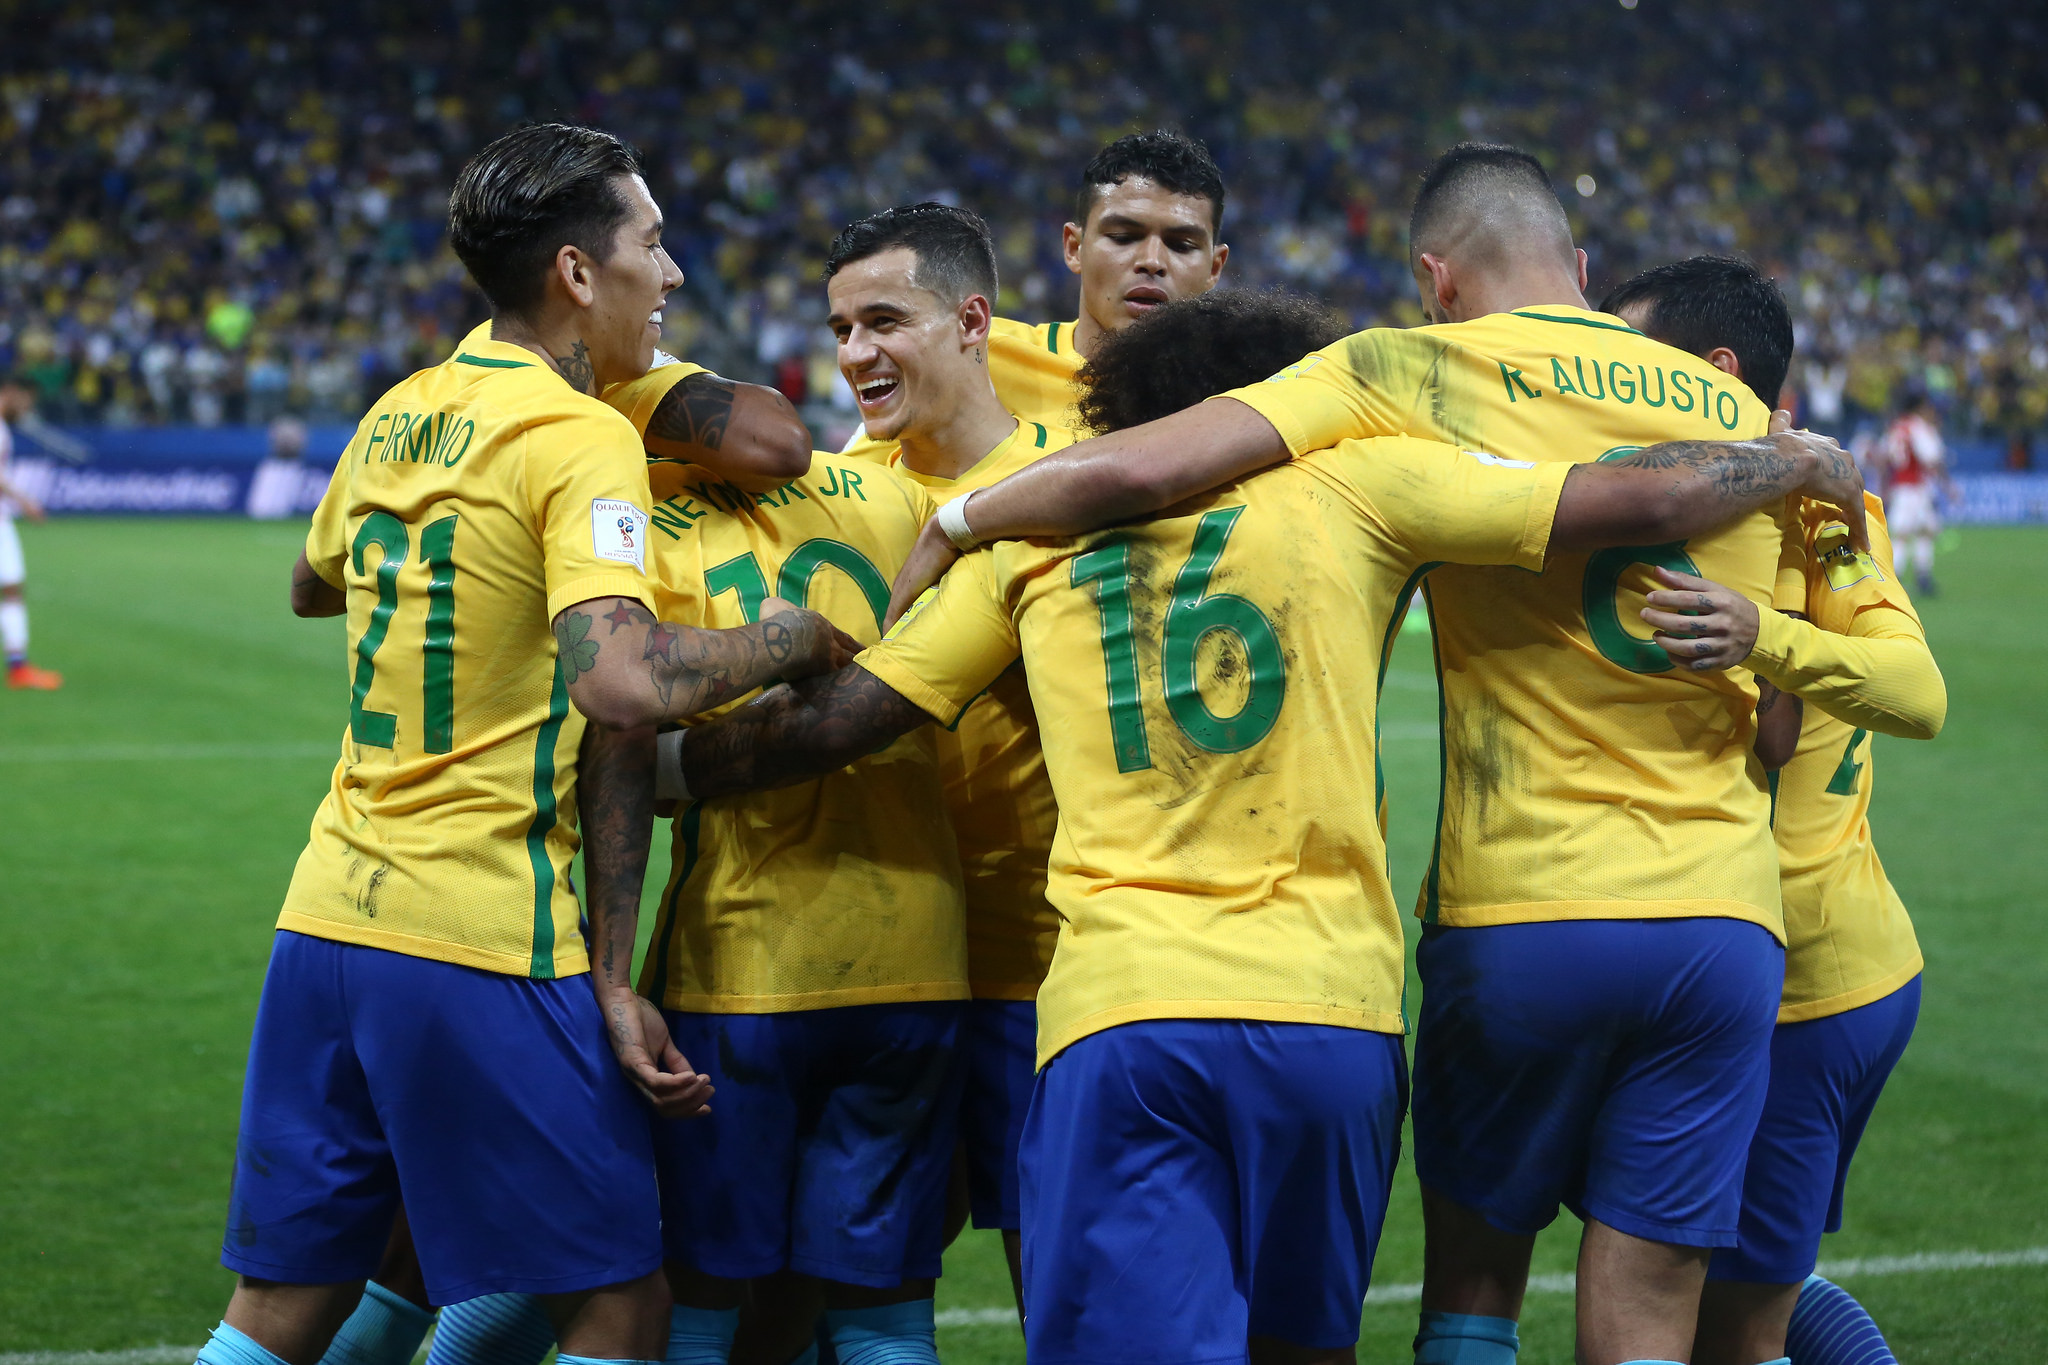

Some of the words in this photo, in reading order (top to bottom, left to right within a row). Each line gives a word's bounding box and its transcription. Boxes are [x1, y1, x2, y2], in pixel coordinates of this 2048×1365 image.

[1498, 362, 1542, 403] R.
[1551, 356, 1739, 430] AUGUSTO
[365, 411, 475, 468] FIRMINO
[595, 503, 644, 524] QUALIFRS
[819, 466, 867, 501] JR
[351, 510, 459, 754] 21
[1070, 504, 1285, 774] 16
